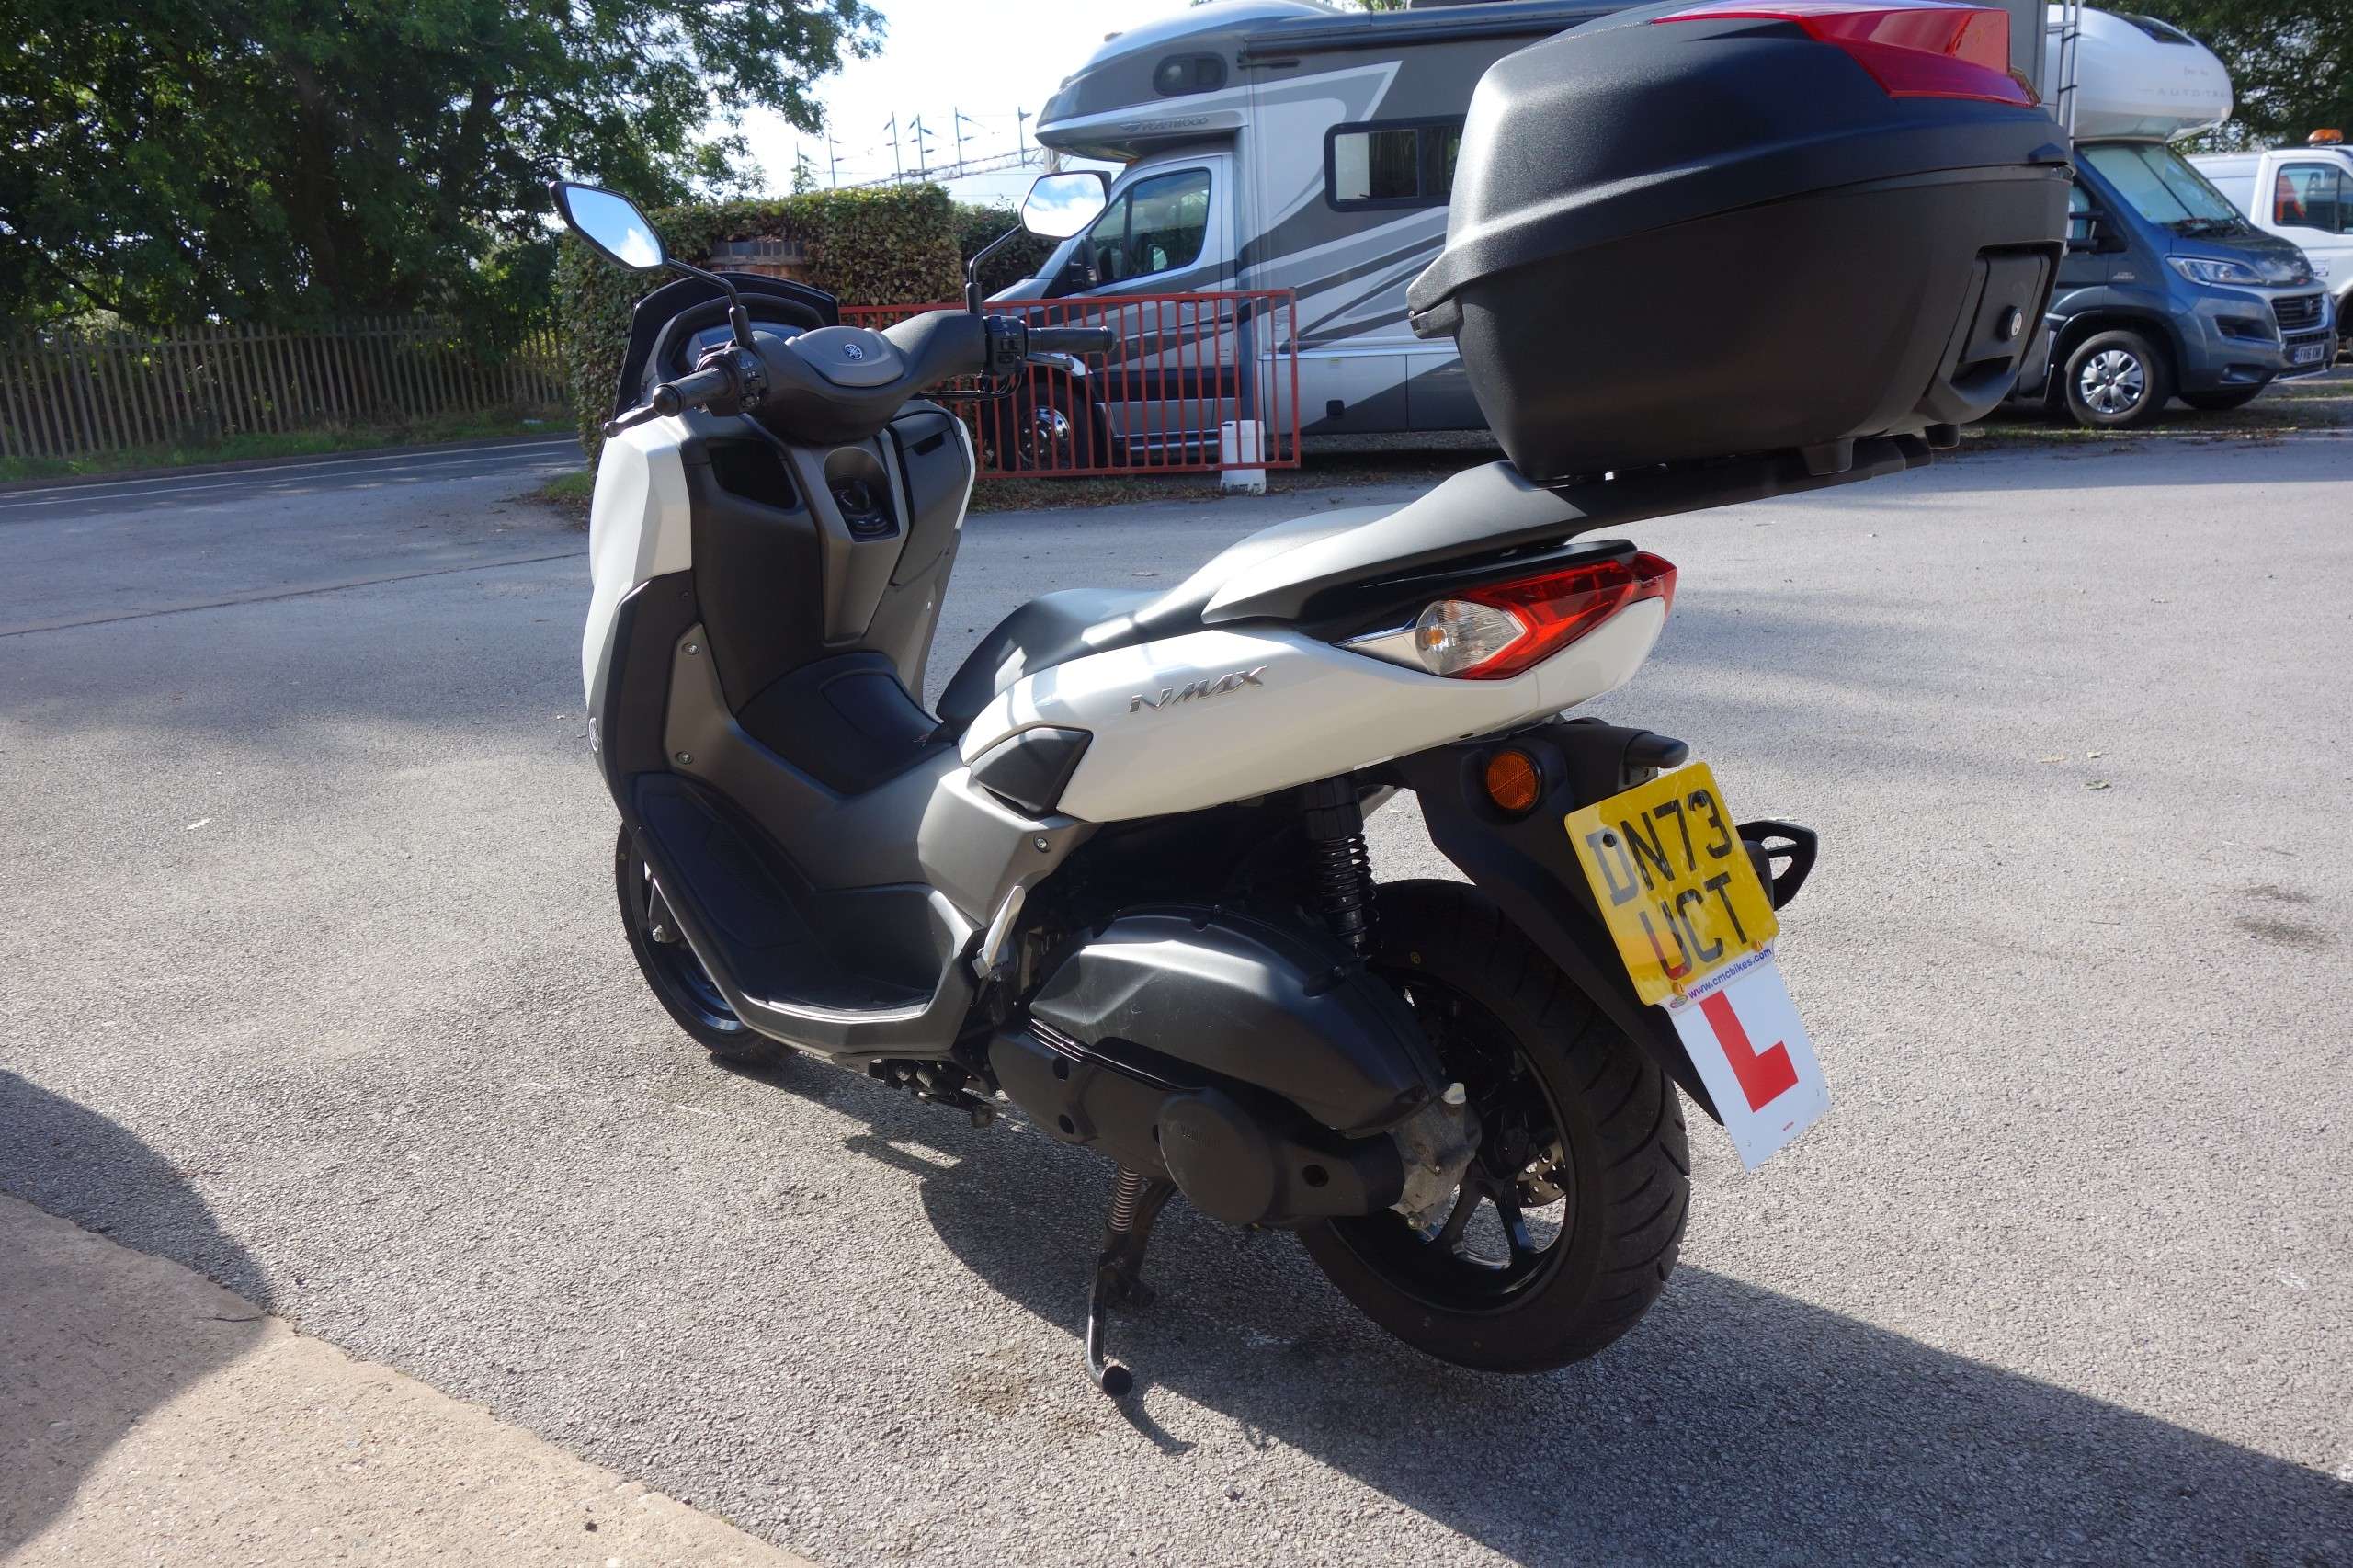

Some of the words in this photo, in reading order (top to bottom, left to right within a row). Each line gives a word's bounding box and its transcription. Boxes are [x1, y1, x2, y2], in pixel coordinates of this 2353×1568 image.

[1130, 665, 1269, 713] NMAX
[1585, 789, 1733, 906] DN73
[1638, 871, 1748, 980] UCT
[1688, 948, 1772, 999] www.cmcbikes.com
[1699, 989, 1799, 1113] L
